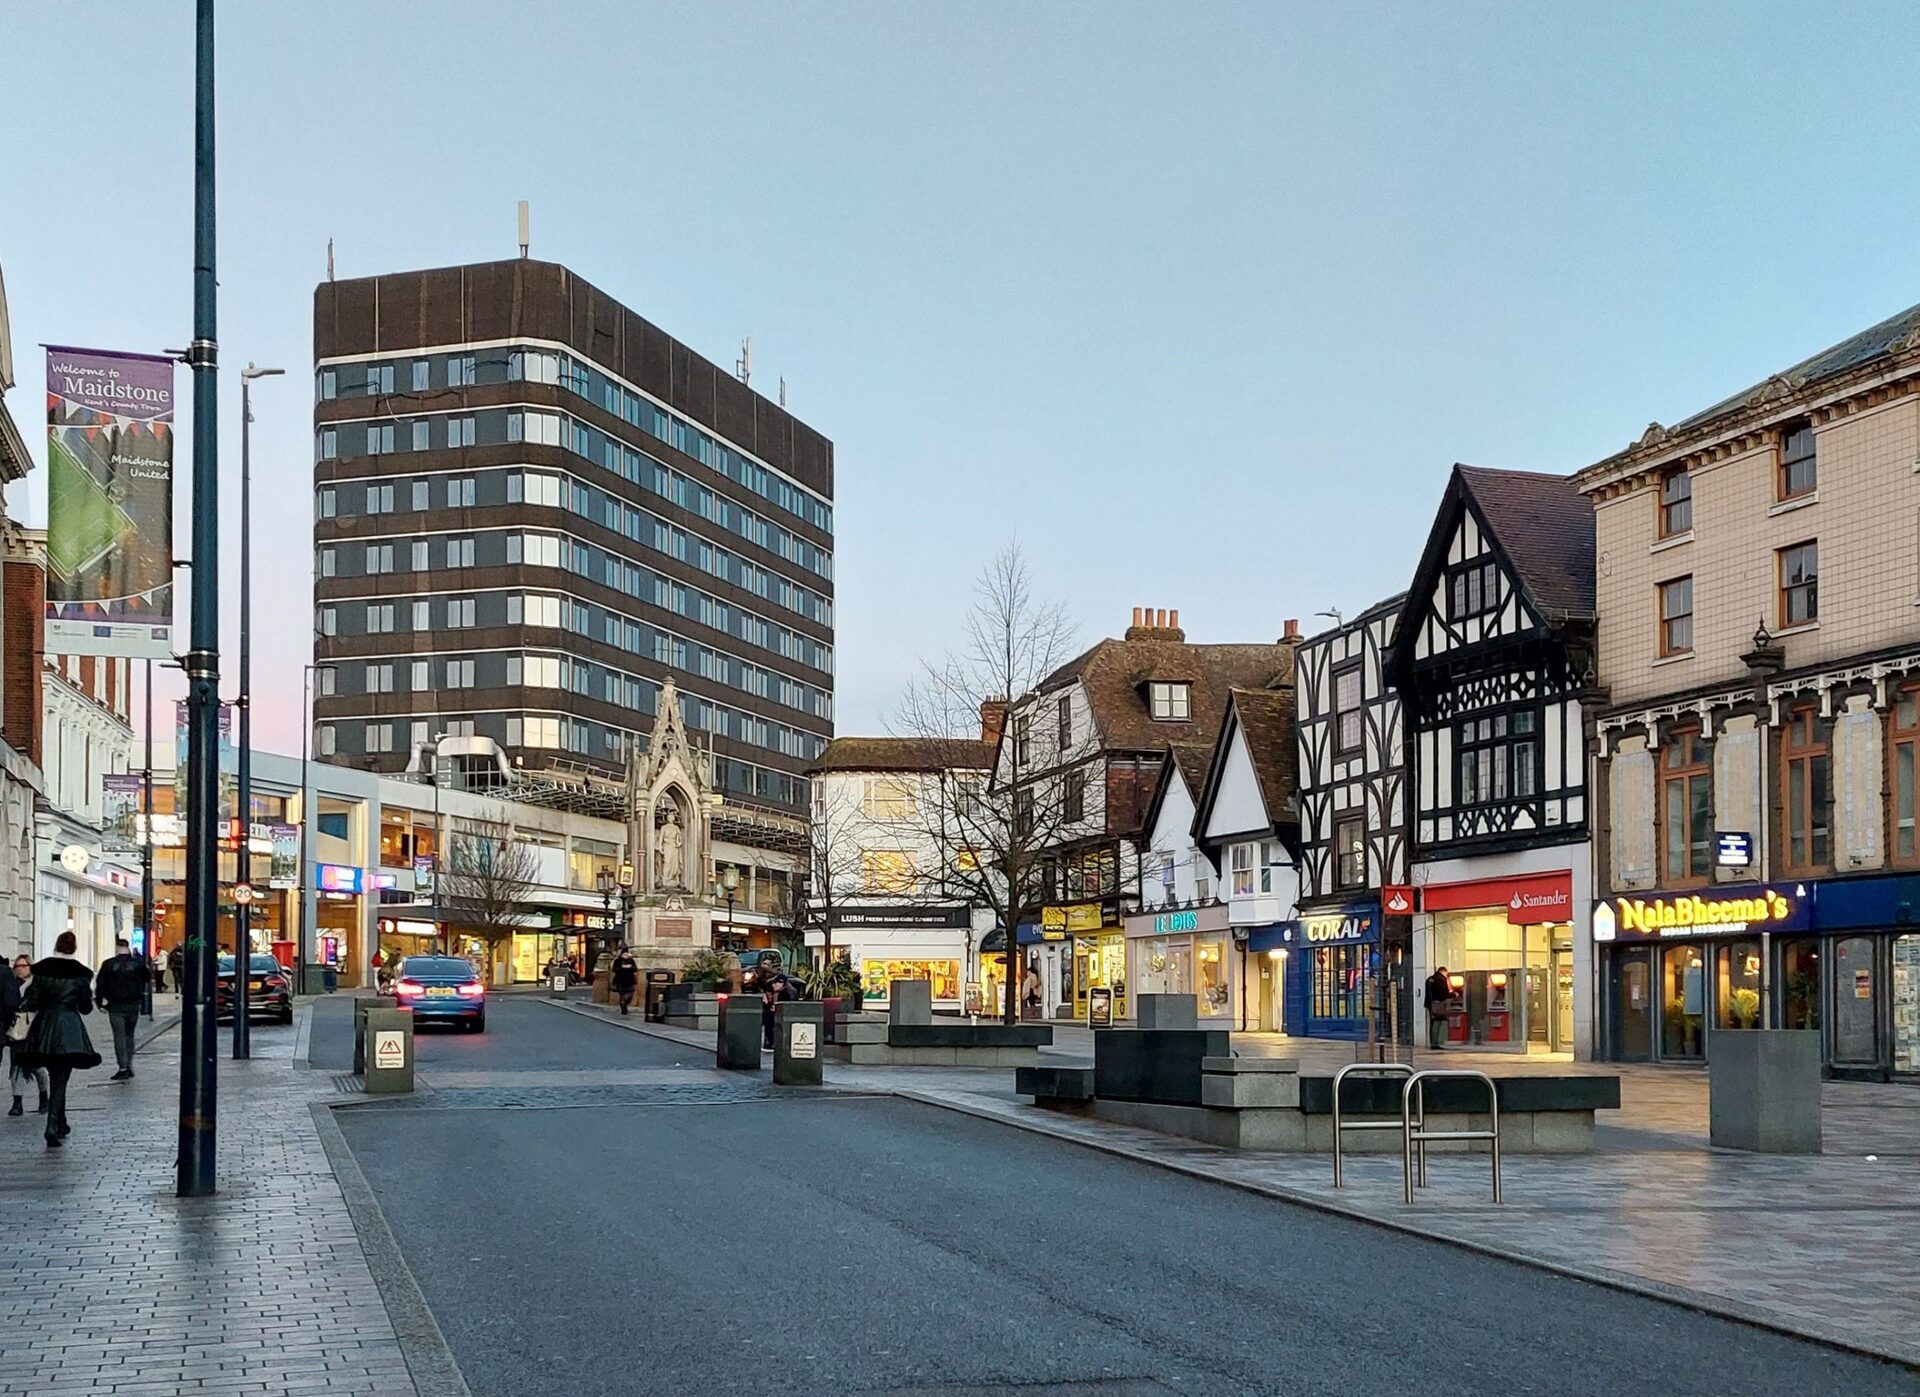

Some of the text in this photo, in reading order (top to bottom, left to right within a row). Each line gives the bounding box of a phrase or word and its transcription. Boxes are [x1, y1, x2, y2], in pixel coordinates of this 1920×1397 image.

[51, 362, 120, 378] Welcome to
[63, 376, 169, 402] Maidstone
[110, 400, 139, 410] County
[141, 402, 162, 412] Town
[111, 454, 170, 468] Maidstone
[130, 467, 170, 480] United
[236, 888, 252, 898] 20
[1523, 889, 1569, 908] Santander
[841, 914, 865, 923] LUSH
[1617, 889, 1789, 933] NalaBheema's
[587, 915, 614, 930] GREGS
[1169, 911, 1198, 931] LOTUS
[1307, 918, 1362, 942] CORAL
